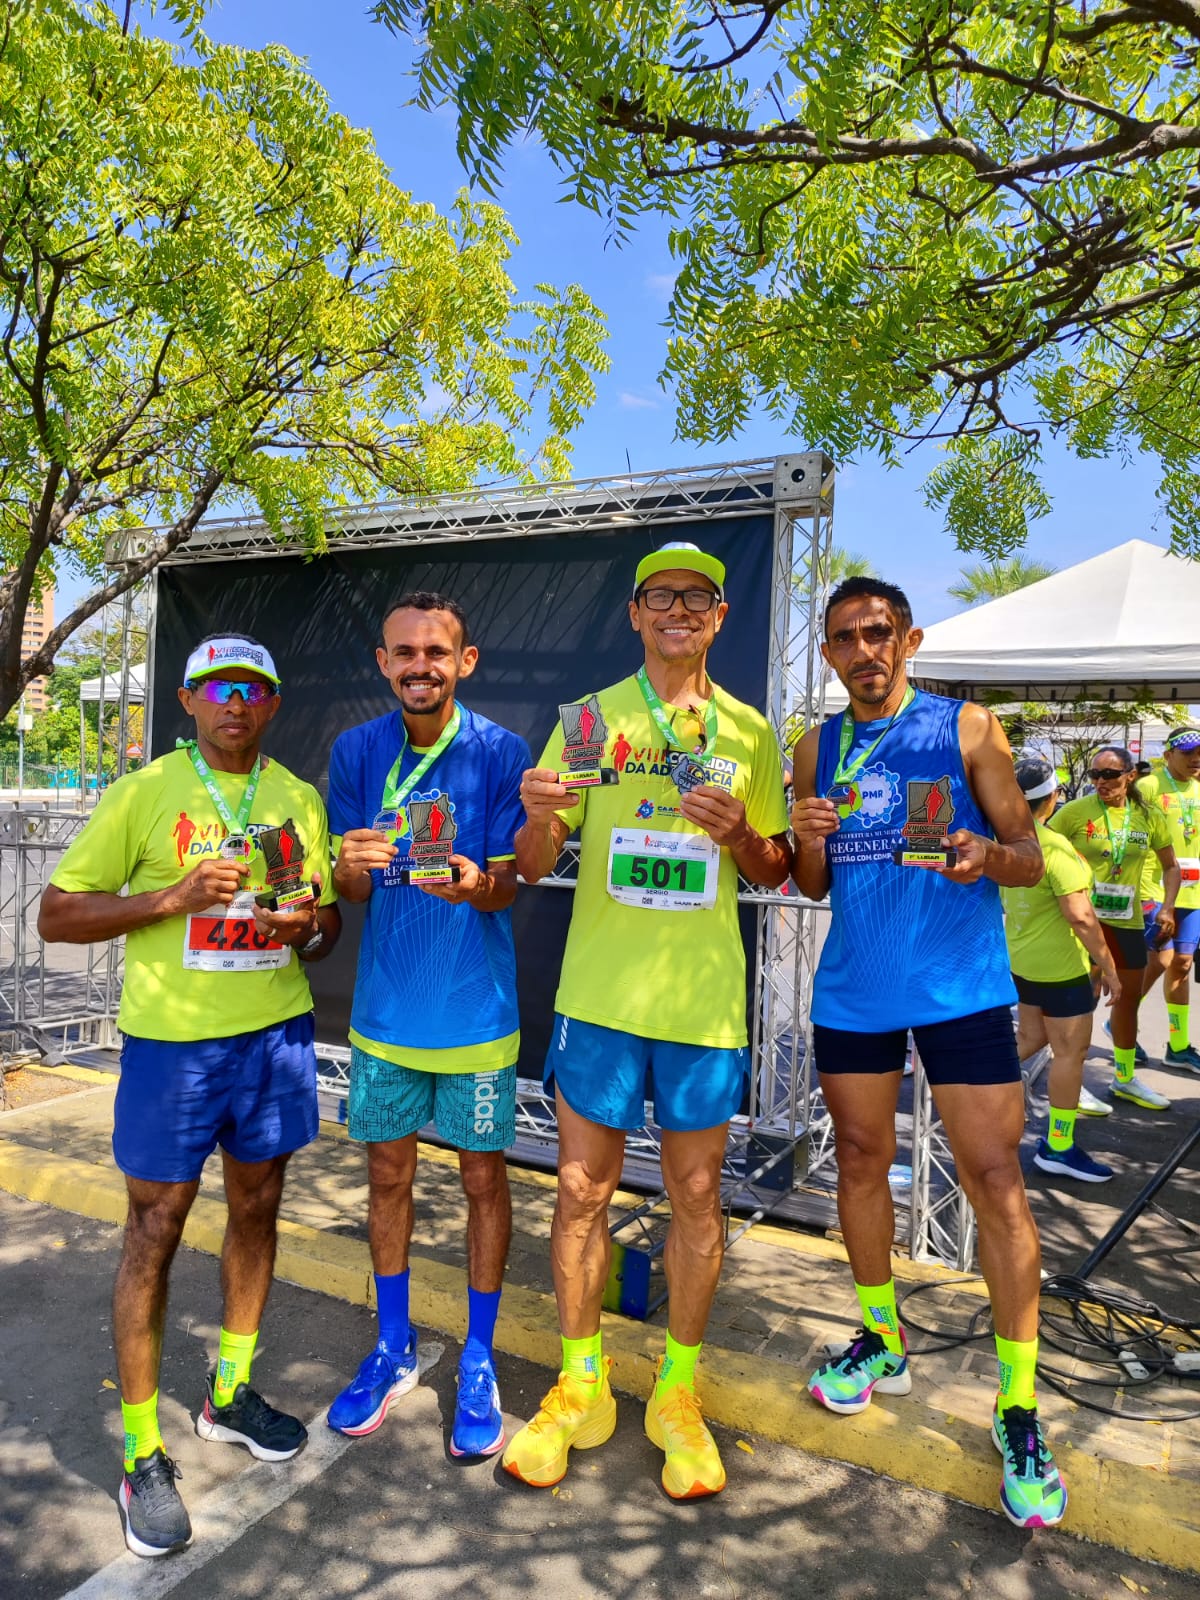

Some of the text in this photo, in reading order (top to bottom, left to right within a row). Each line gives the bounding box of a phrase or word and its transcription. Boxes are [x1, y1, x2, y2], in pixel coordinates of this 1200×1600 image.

[625, 762, 646, 775] DA
[649, 762, 733, 788] ADACIA
[862, 789, 884, 800] PMR
[874, 828, 902, 837] MUNICIPA
[190, 841, 214, 856] DA
[857, 854, 873, 862] COM
[630, 857, 688, 890] 501
[474, 1070, 499, 1135] idas
